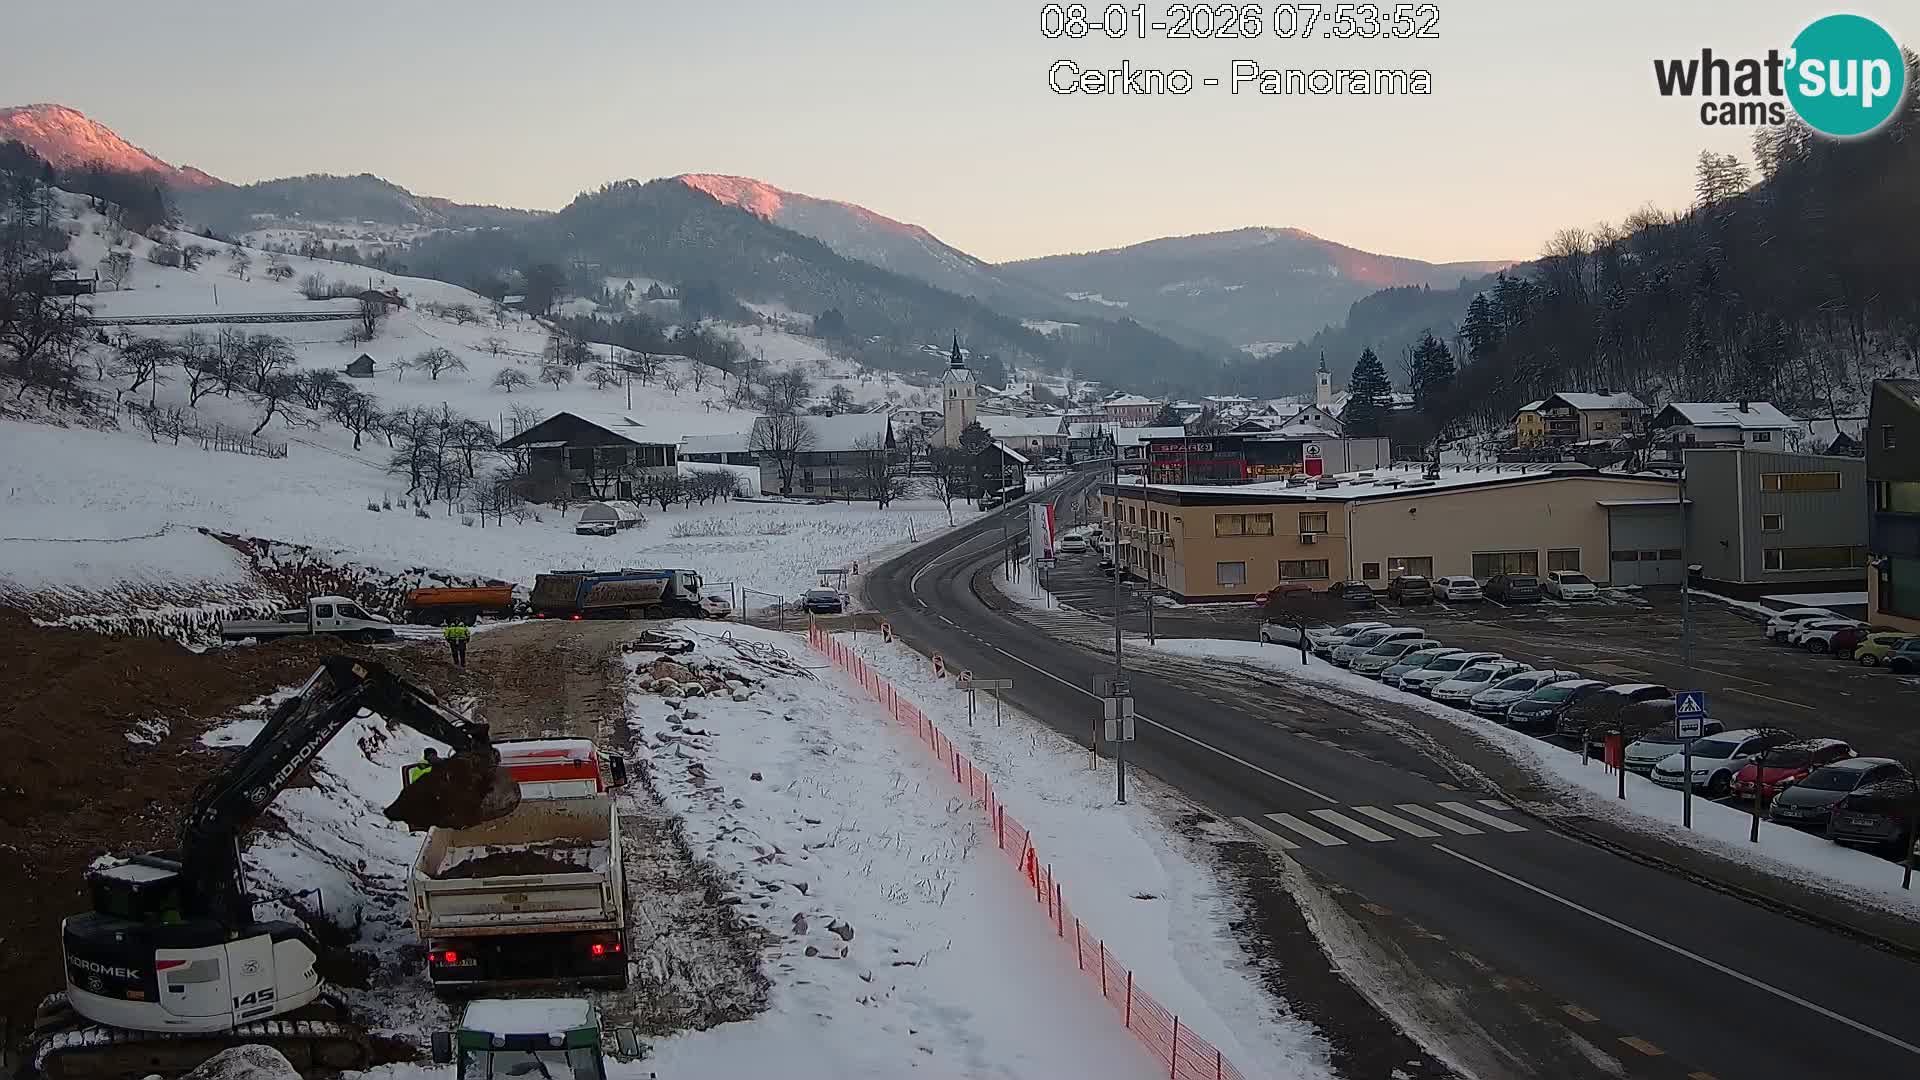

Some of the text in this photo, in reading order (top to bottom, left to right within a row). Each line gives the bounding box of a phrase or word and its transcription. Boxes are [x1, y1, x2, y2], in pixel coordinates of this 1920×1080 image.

[1160, 444, 1197, 452] SPAR
[269, 720, 341, 790] HIDROMEK
[233, 987, 274, 1009] 145
